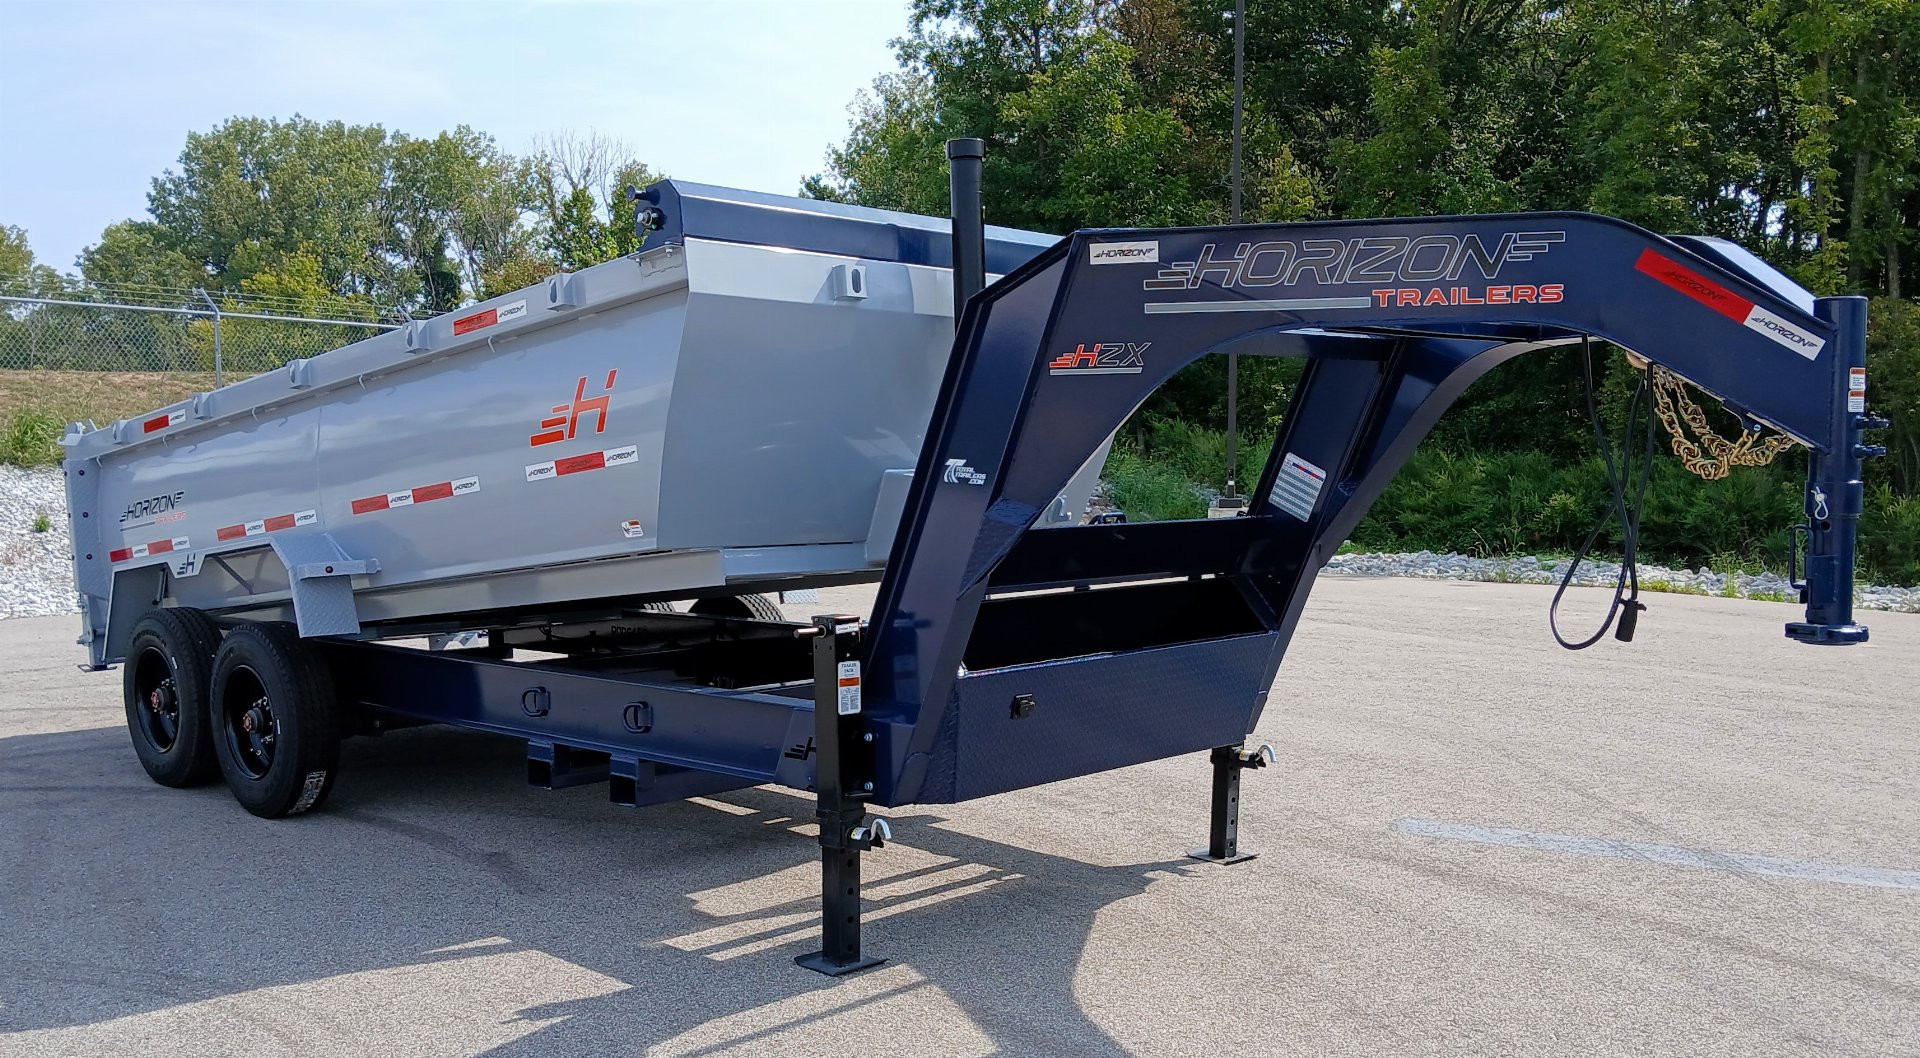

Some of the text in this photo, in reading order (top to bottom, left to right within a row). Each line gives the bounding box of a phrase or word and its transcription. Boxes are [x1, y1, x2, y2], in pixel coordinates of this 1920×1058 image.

[1099, 248, 1148, 258] HORIZON
[1188, 233, 1515, 289] HORIZON
[1372, 283, 1565, 308] TRAILERS
[1669, 271, 1720, 300] HORIZON
[1758, 316, 1812, 347] HORIZON
[1068, 342, 1152, 367] HZX
[955, 472, 987, 480] TRAILERS
[125, 493, 178, 521] HORIZON
[155, 511, 188, 525] TRAILERS
